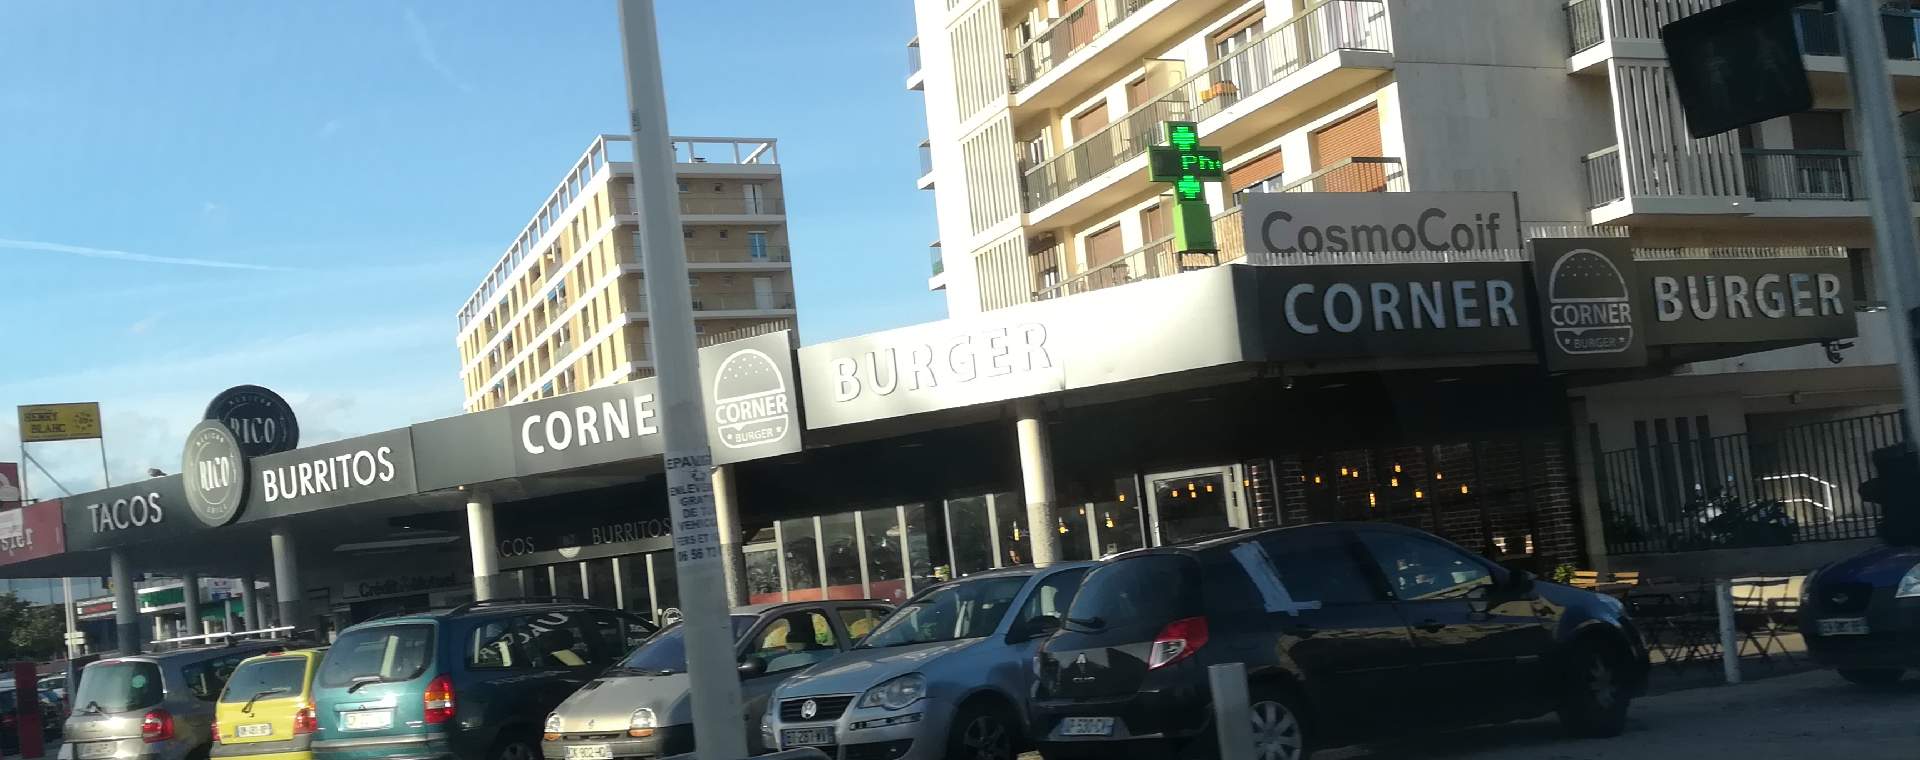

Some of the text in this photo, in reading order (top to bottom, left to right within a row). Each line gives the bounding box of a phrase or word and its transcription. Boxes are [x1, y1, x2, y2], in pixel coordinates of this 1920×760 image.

[1260, 208, 1501, 254] CosmoCoif
[1284, 272, 1845, 334] CORNER BURGER
[1550, 302, 1633, 327] CORNER
[831, 322, 1053, 403] BURGER
[1573, 335, 1618, 350] BURGER
[520, 392, 659, 455] CORNE
[714, 394, 789, 426] CORNER
[734, 426, 774, 443] BURGER
[199, 456, 230, 491] RICO
[262, 446, 395, 502] BURRITOS
[87, 492, 163, 533] TACOS
[499, 536, 535, 558] COS
[592, 517, 672, 545] BURRITOS
